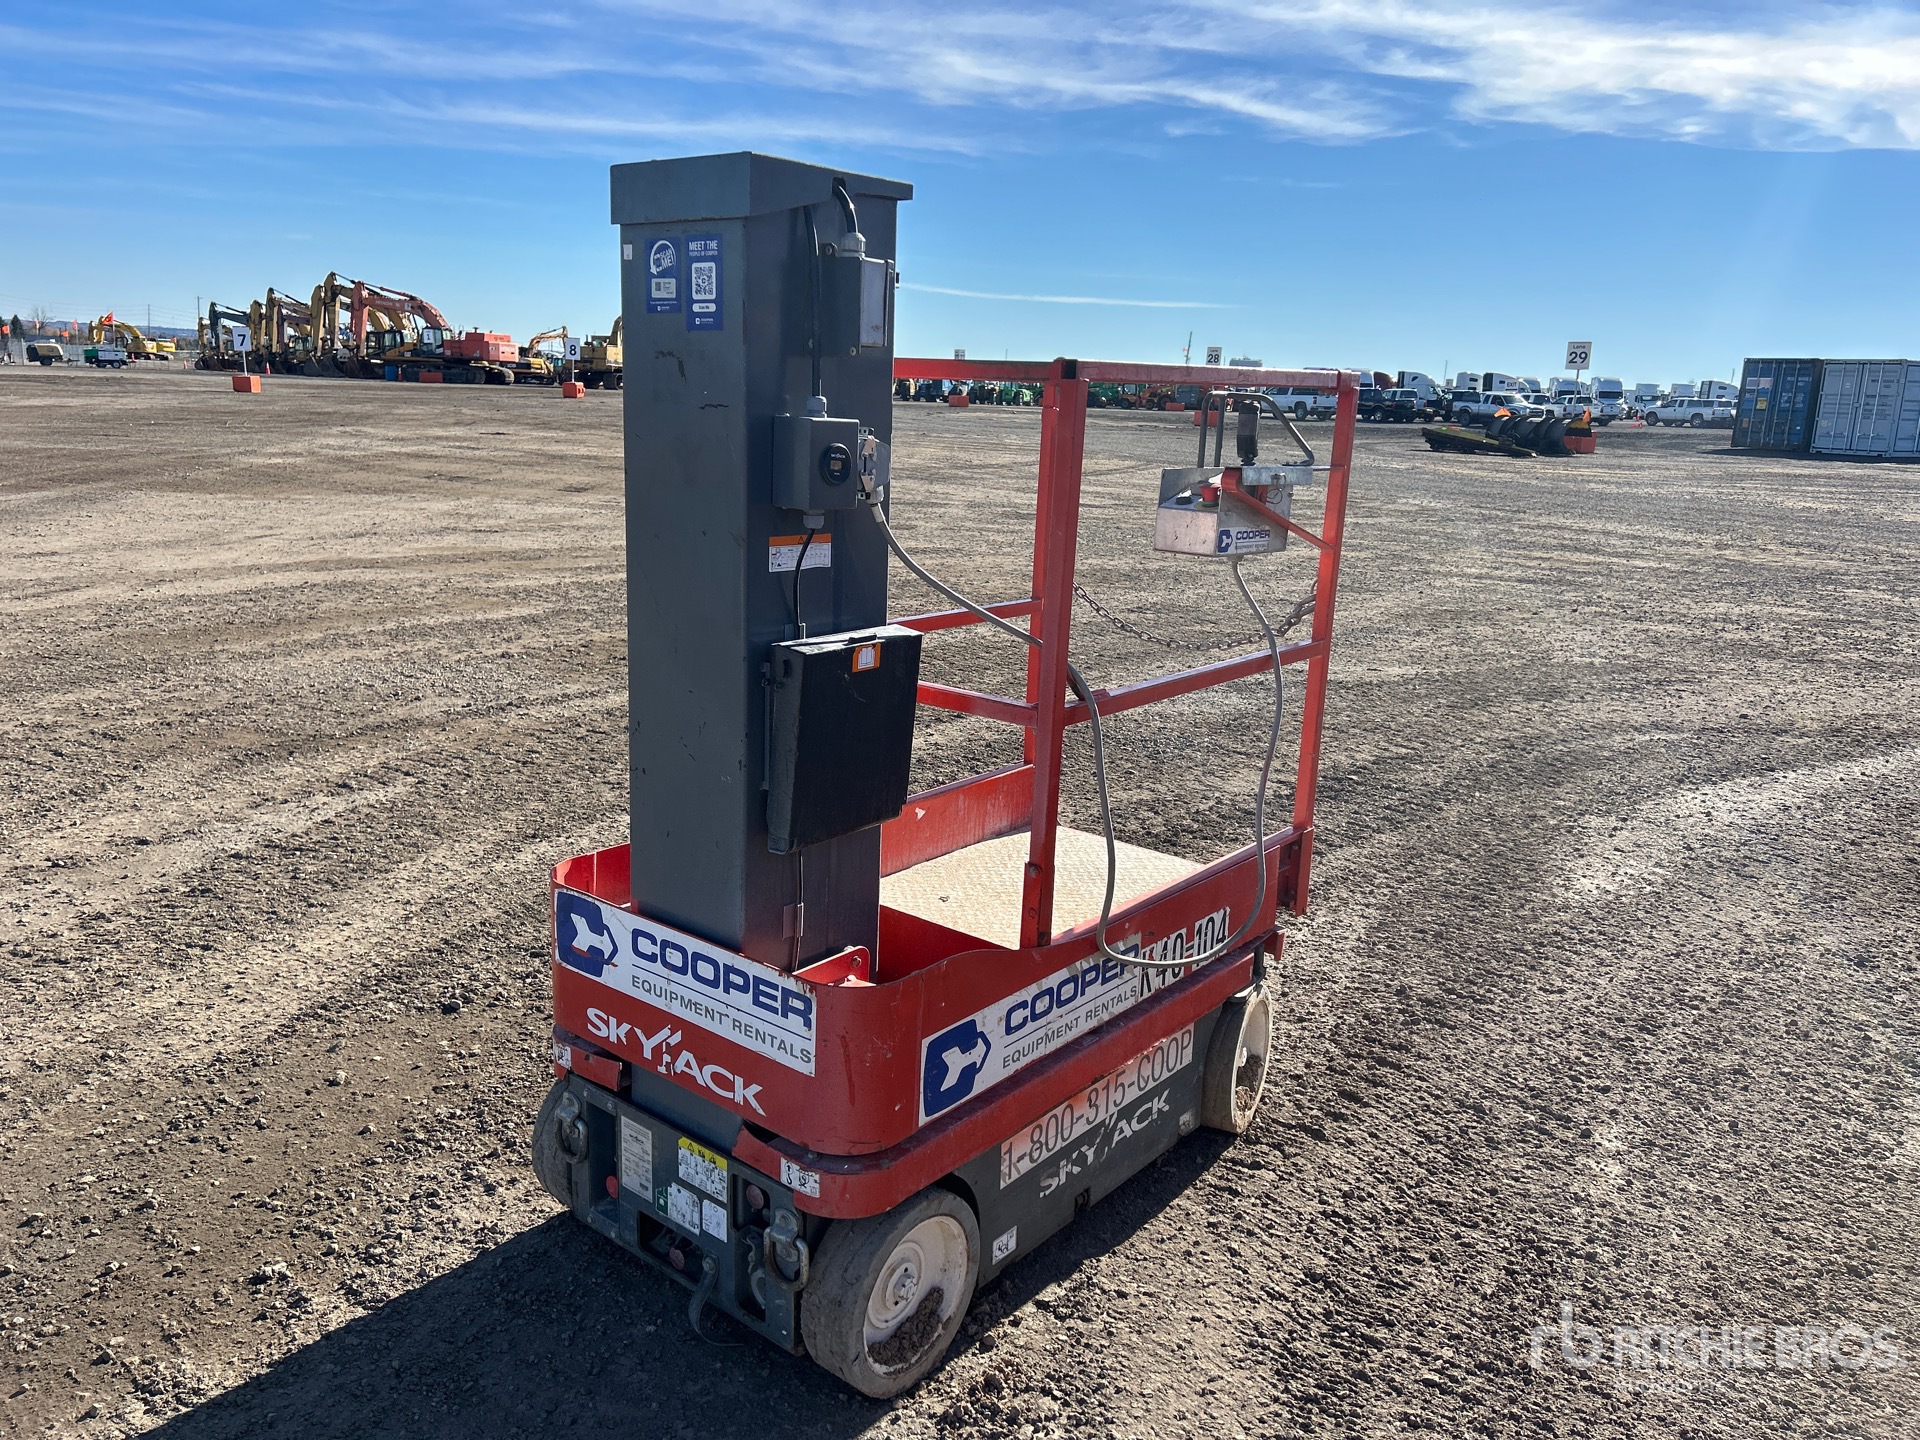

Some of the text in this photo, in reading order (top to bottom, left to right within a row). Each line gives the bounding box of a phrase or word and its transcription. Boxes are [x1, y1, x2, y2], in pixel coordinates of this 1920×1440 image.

[689, 240, 718, 251] MEET THE
[237, 333, 246, 347] 7
[569, 344, 577, 356] 8
[1208, 354, 1220, 363] 28
[1568, 351, 1588, 364] 29
[1236, 530, 1270, 540] COOPER
[631, 927, 813, 1032] COOPER
[1004, 909, 1229, 1037] COOPER K40-104
[631, 974, 812, 1064] EQUIPMENT RENTALS
[1002, 985, 1138, 1070] EQUIPMENT RENTALS
[1003, 1028, 1193, 1182] 1-800-315-COOP
